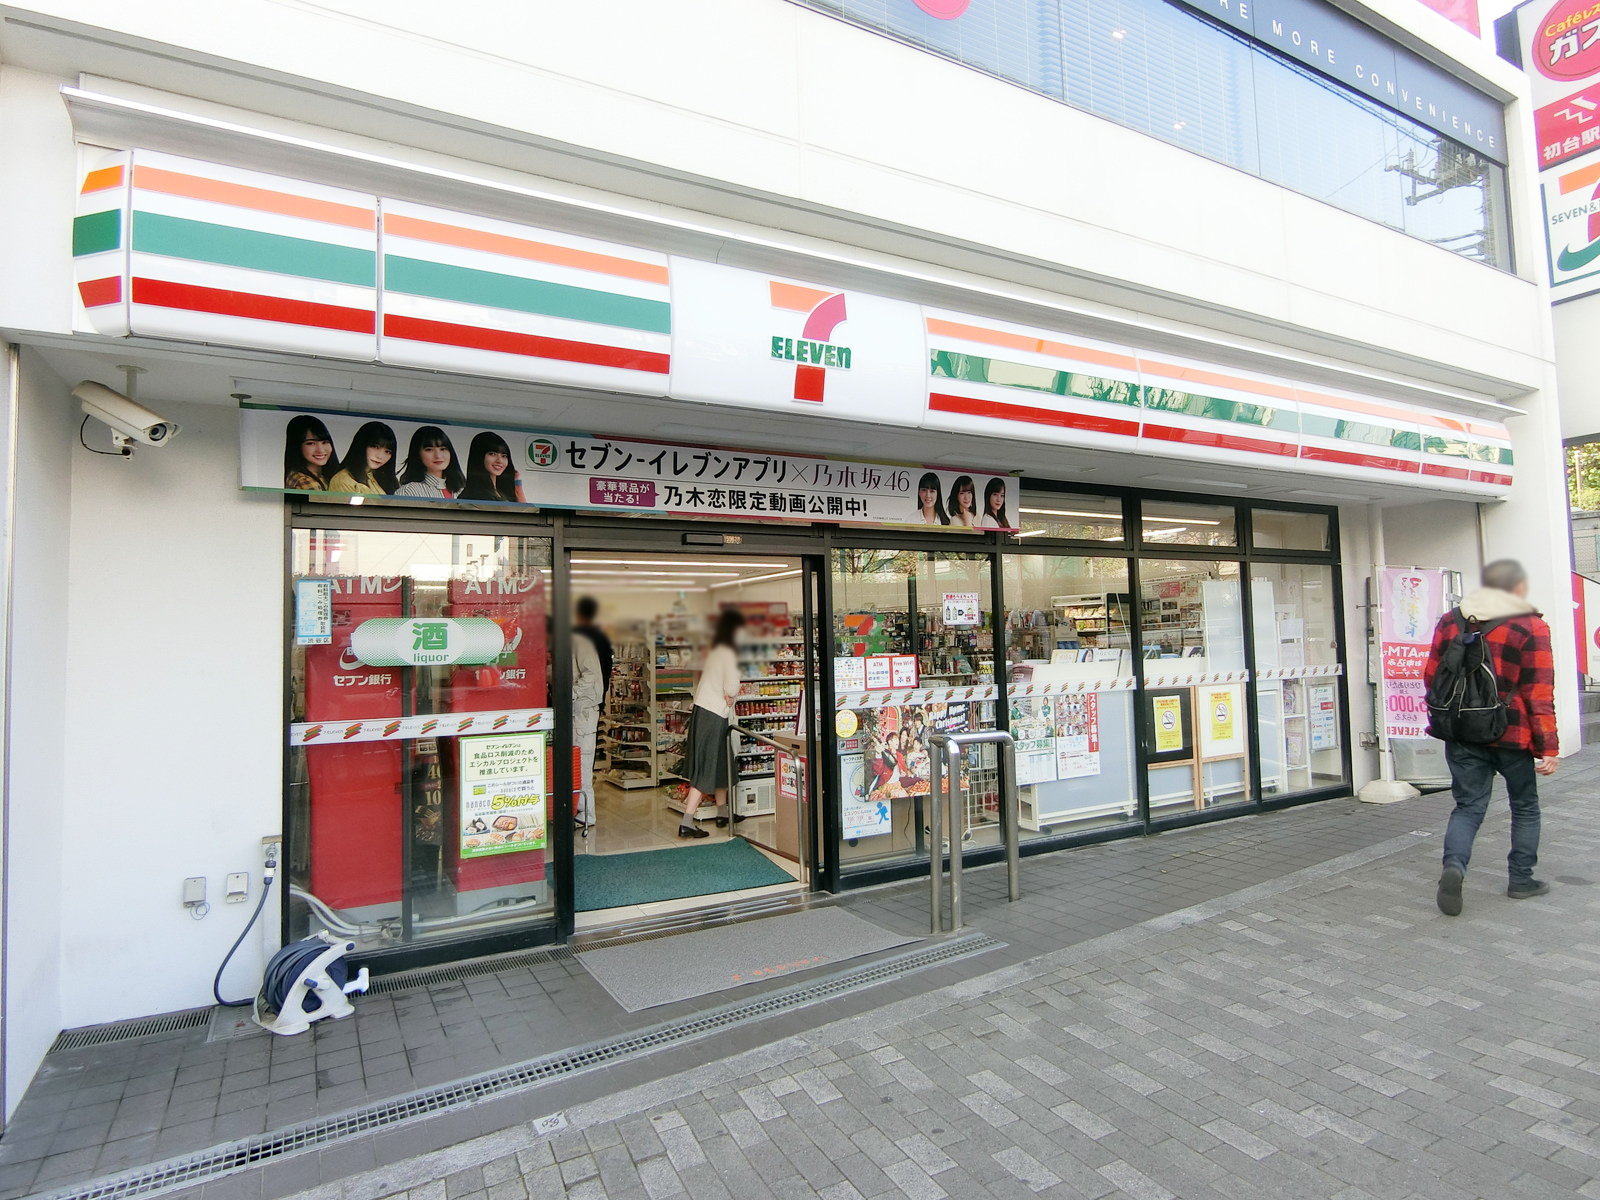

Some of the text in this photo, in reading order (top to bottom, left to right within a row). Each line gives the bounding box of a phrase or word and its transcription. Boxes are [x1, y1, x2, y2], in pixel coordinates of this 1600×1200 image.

[1272, 20, 1336, 64] MORE
[1355, 65, 1495, 148] CONVENIENCE
[1543, 126, 1600, 161] 初台駅
[596, 481, 650, 494] 豪華景品が
[412, 622, 448, 651] 酒
[413, 653, 450, 664] liquor
[332, 674, 392, 686] セブン銀行
[474, 749, 534, 760] 食品ロス削減のため
[469, 756, 539, 768] エシカルプロジェクトを
